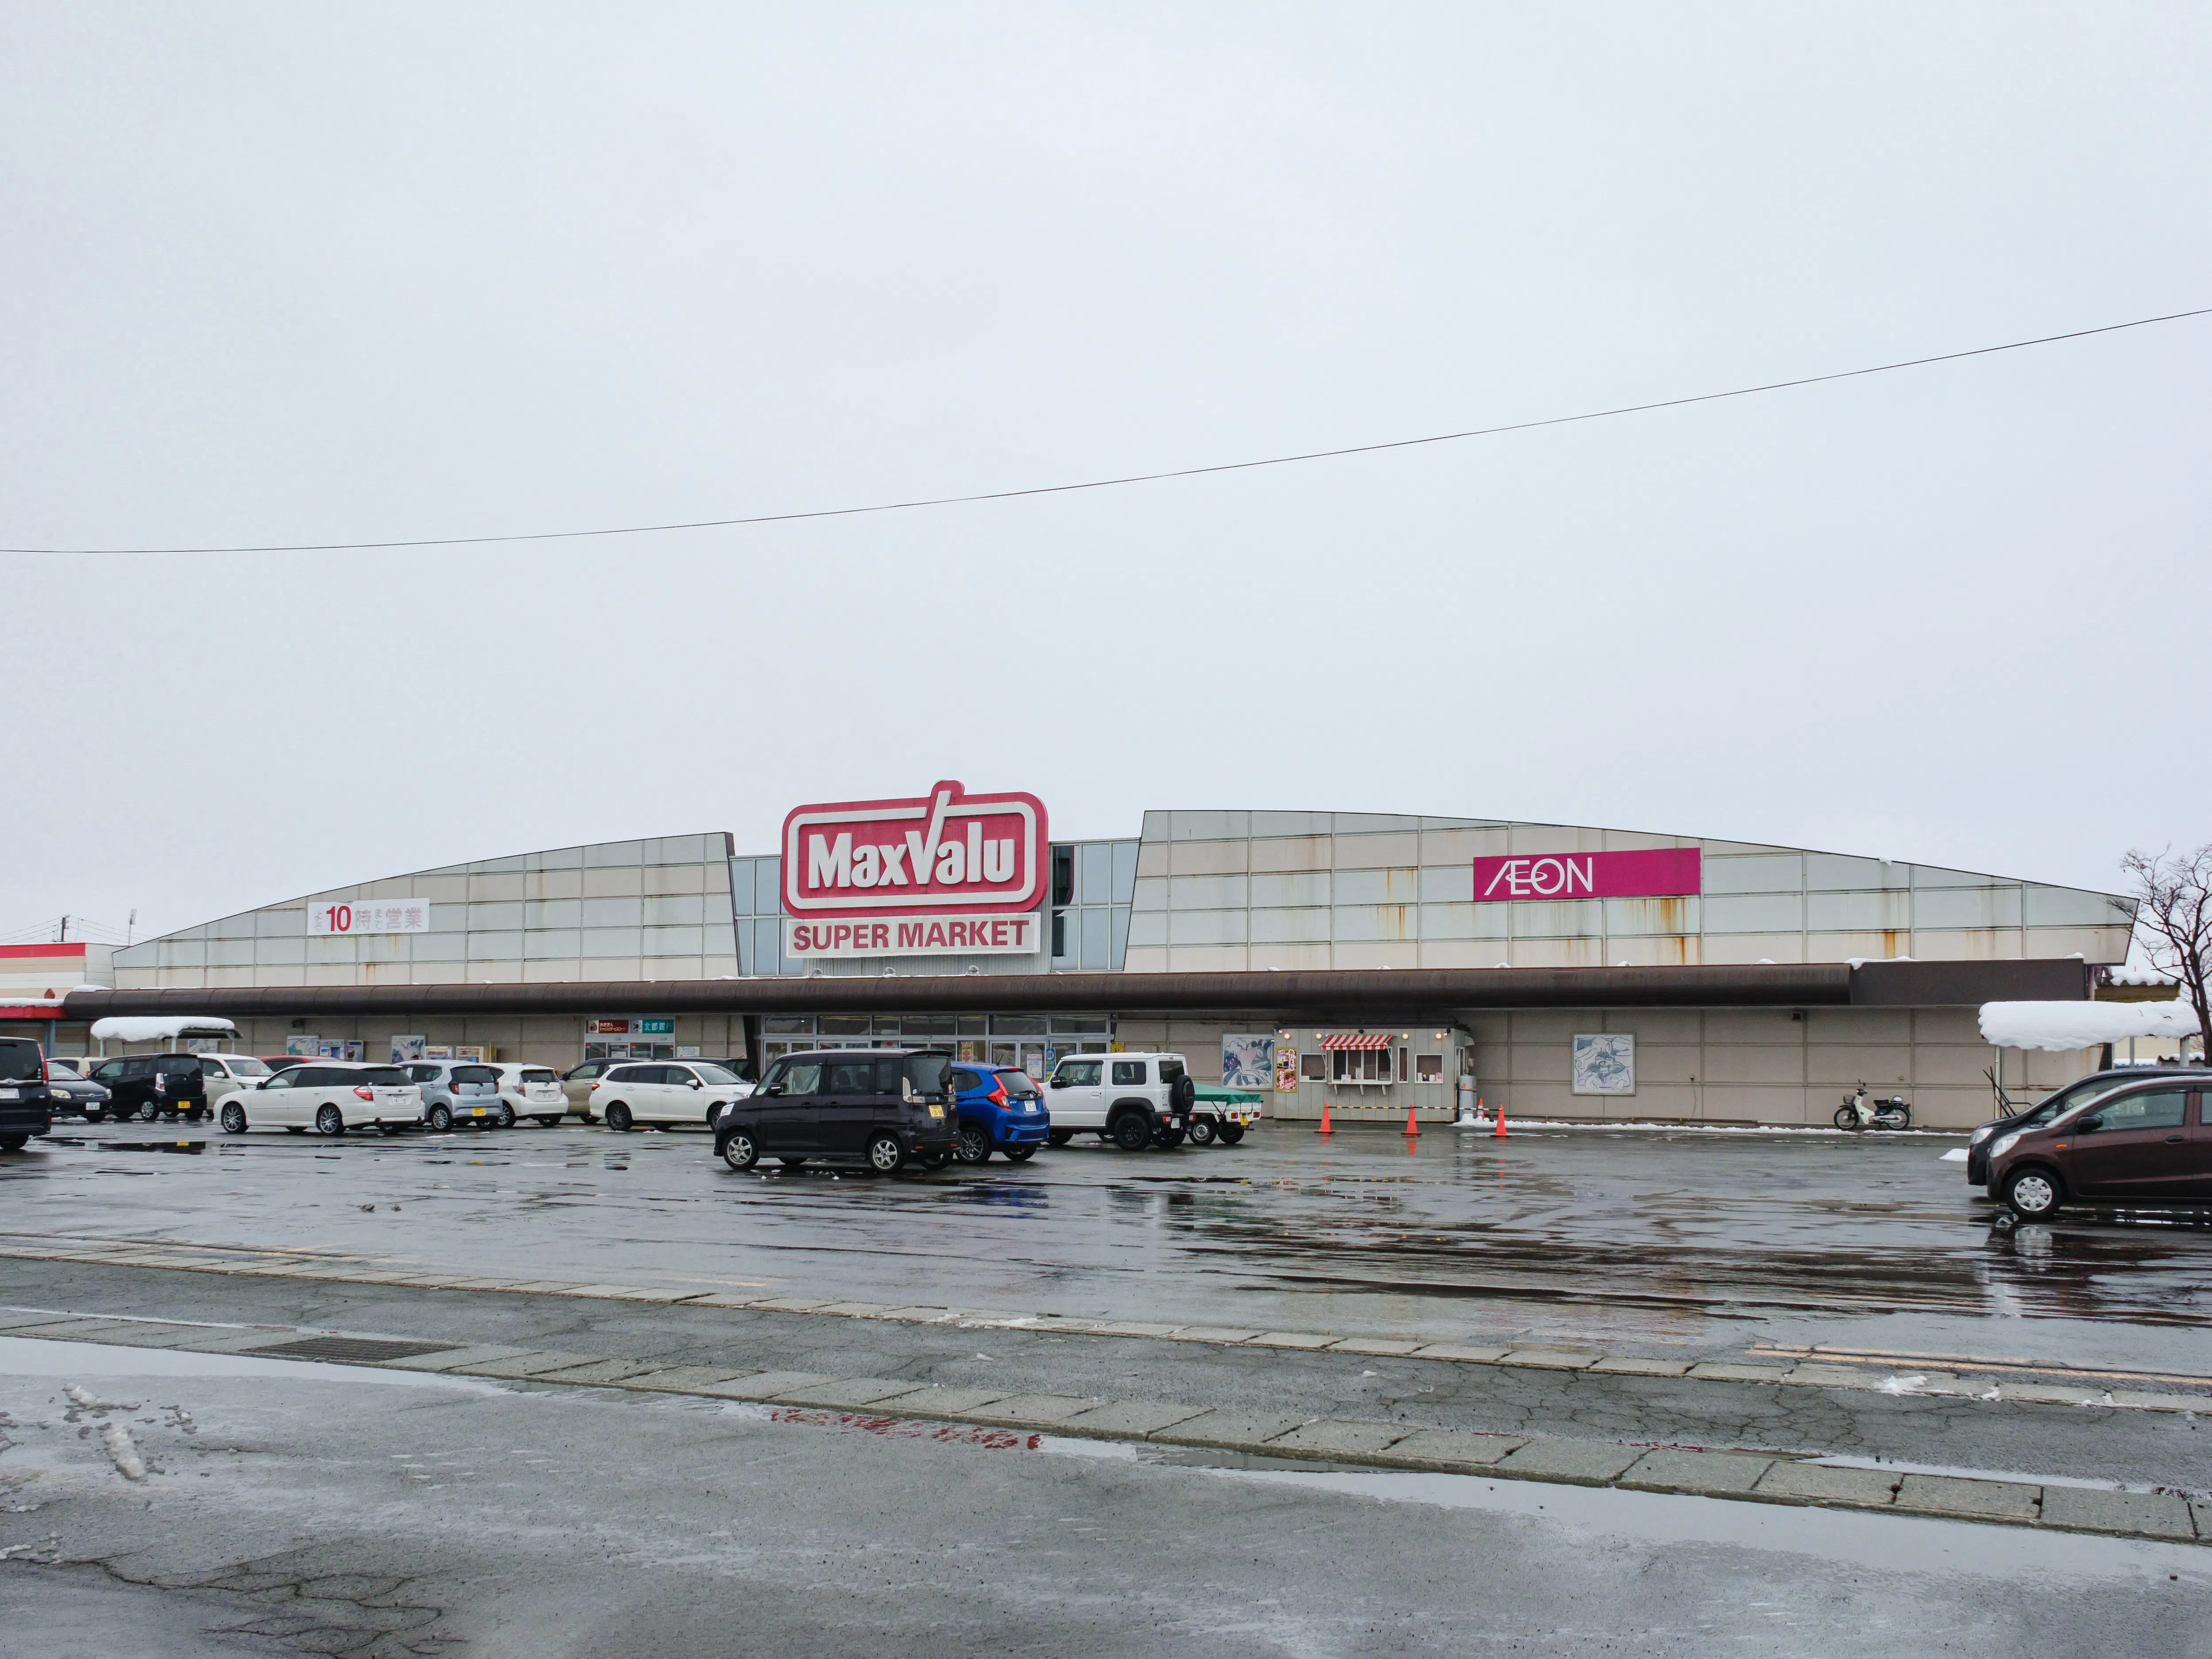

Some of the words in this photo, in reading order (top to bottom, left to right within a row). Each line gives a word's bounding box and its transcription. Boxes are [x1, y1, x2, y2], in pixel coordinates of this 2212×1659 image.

[808, 791, 1015, 889] MaxValu
[794, 924, 889, 950] SUPER
[898, 920, 1029, 948] MARKET
[644, 1022, 673, 1031] 北都銀行
